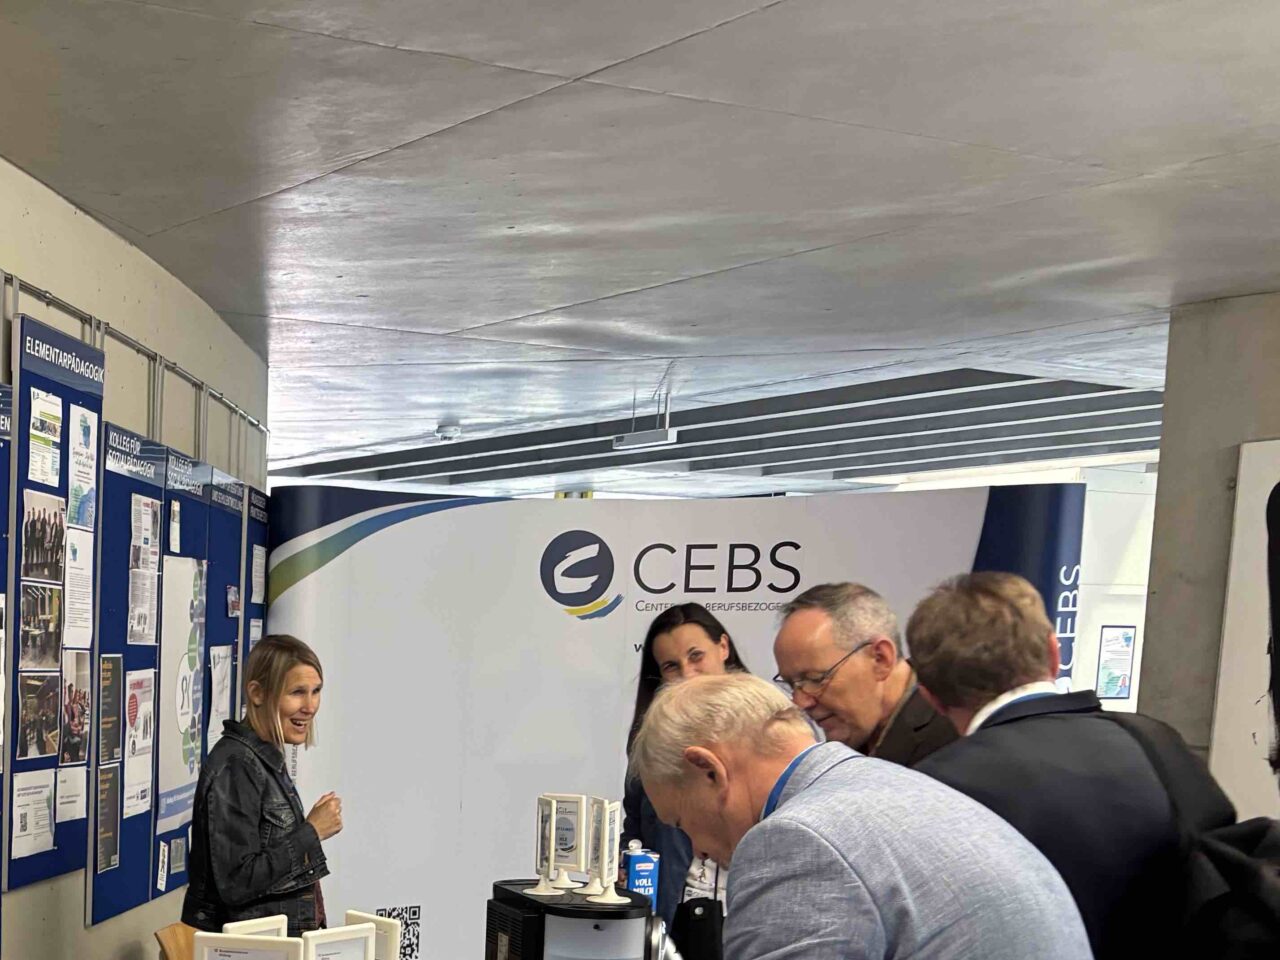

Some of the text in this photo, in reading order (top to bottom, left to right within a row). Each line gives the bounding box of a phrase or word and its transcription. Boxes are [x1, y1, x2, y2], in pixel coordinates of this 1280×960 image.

[25, 336, 104, 383] ELEMENTARPÄDAGOGIK
[109, 430, 141, 455] KOLLEG FÜR
[633, 540, 802, 594] CEBS
[705, 602, 782, 611] BERUFSBEZOGE
[1055, 564, 1081, 671] CEBS
[635, 878, 653, 887] VOLL
